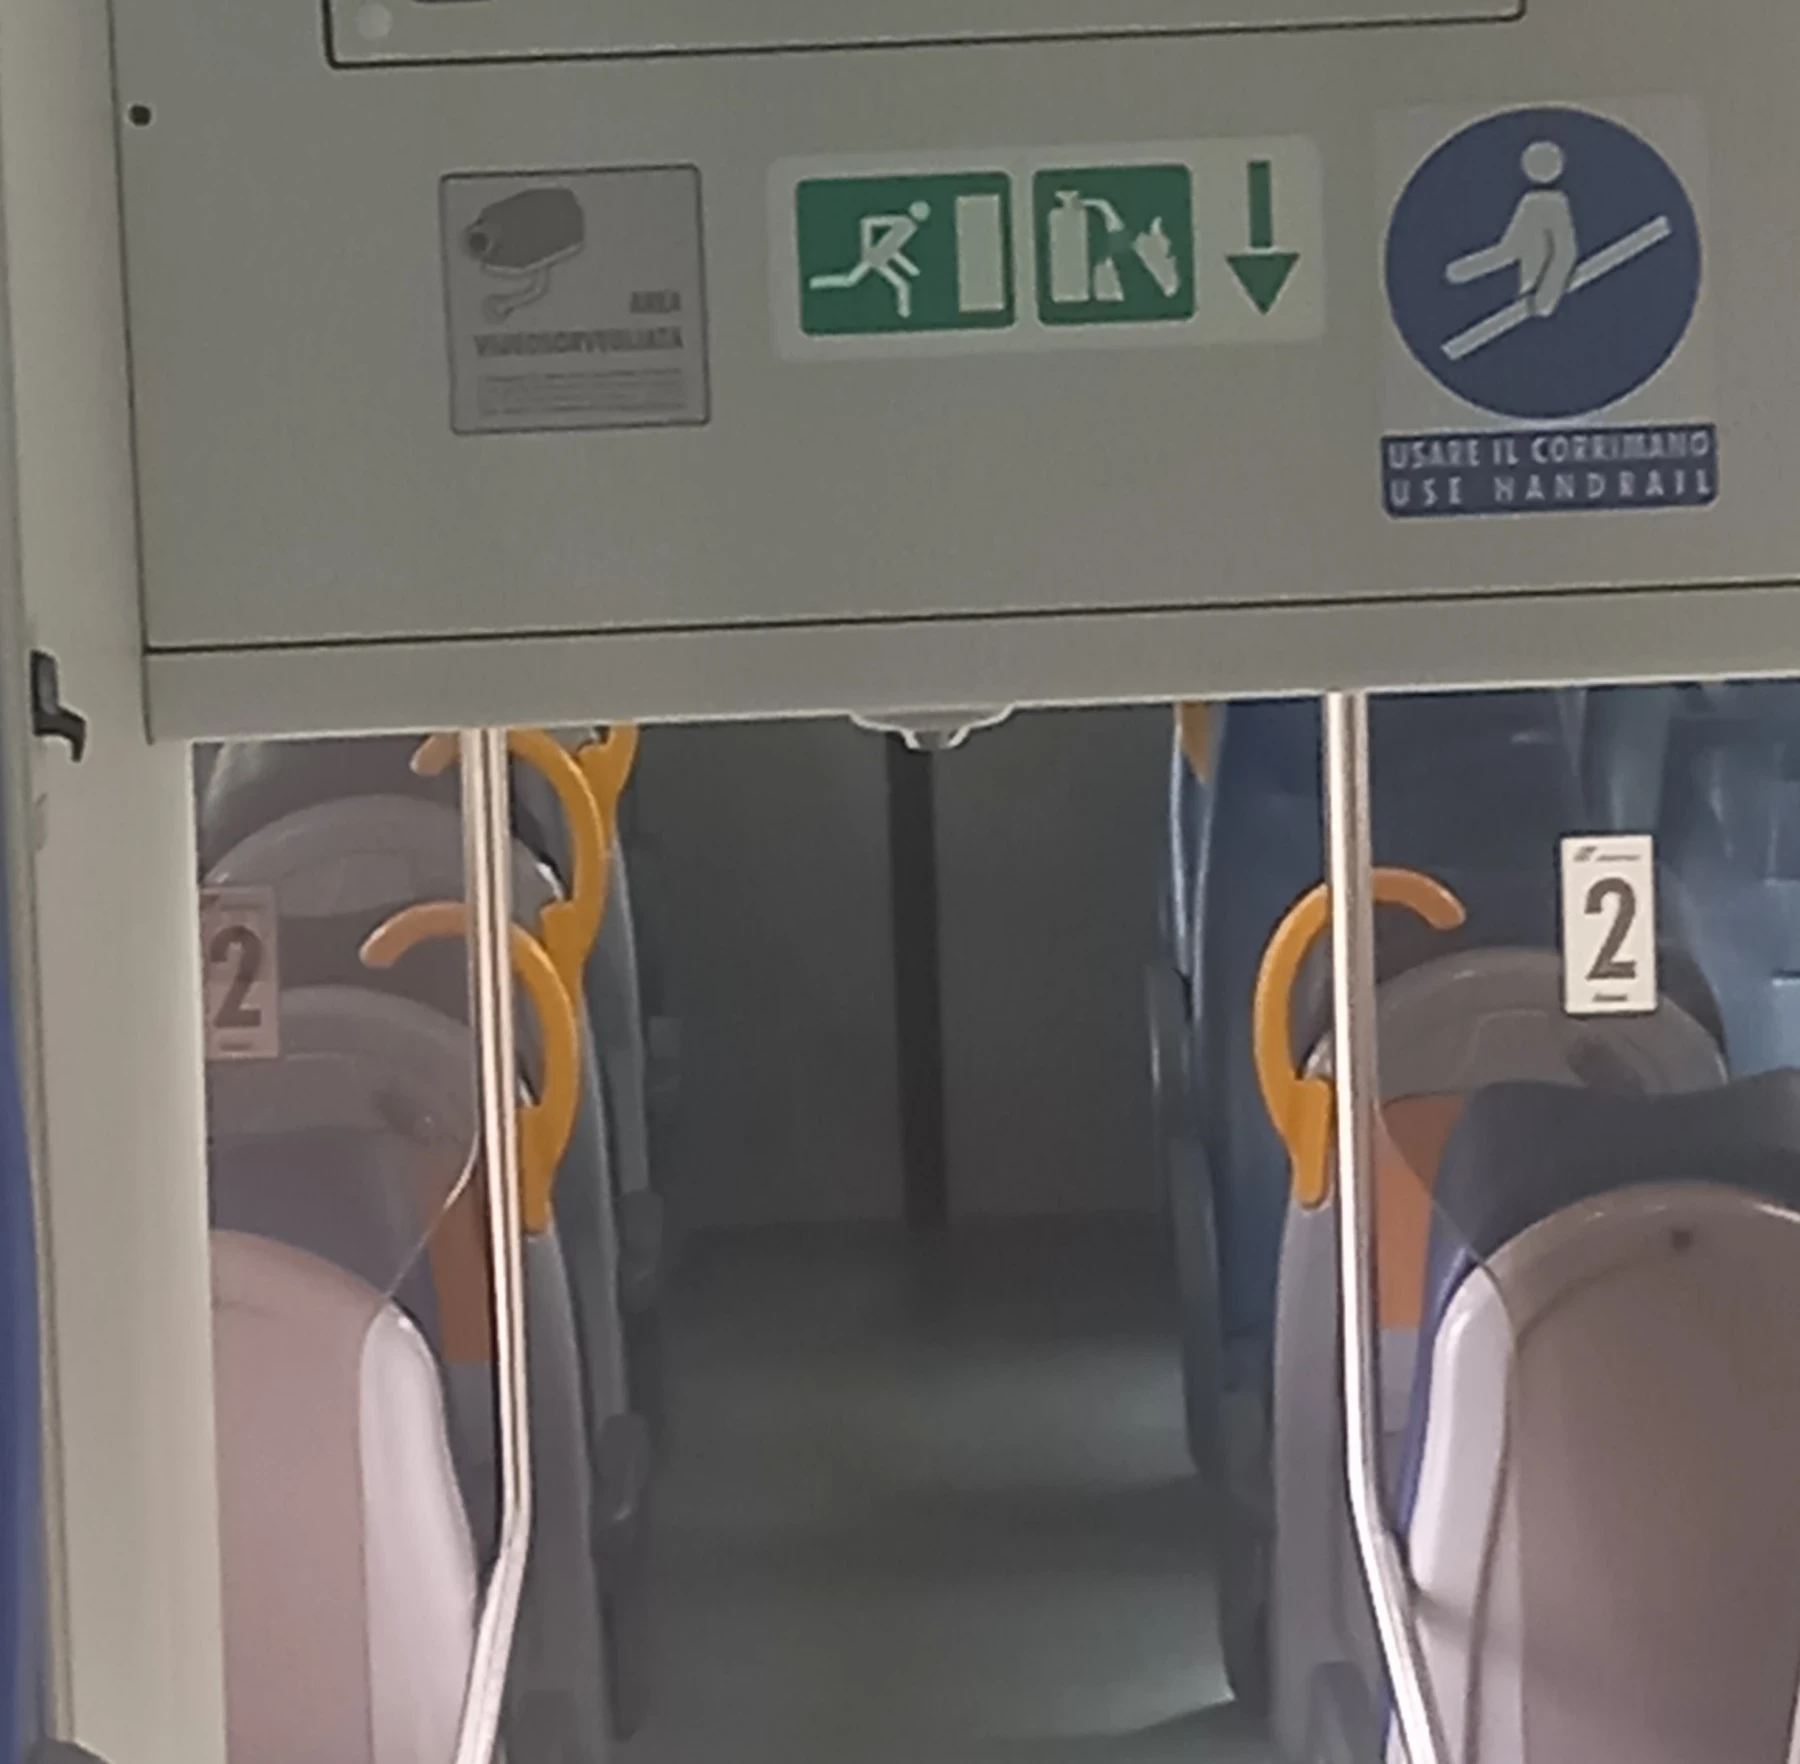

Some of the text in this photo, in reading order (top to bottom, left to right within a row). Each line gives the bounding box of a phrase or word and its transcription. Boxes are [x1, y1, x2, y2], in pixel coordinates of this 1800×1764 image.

[1493, 438, 1519, 465] IL
[1390, 477, 1462, 506] USE
[1584, 877, 1637, 980] 2
[210, 925, 264, 1028] 2
